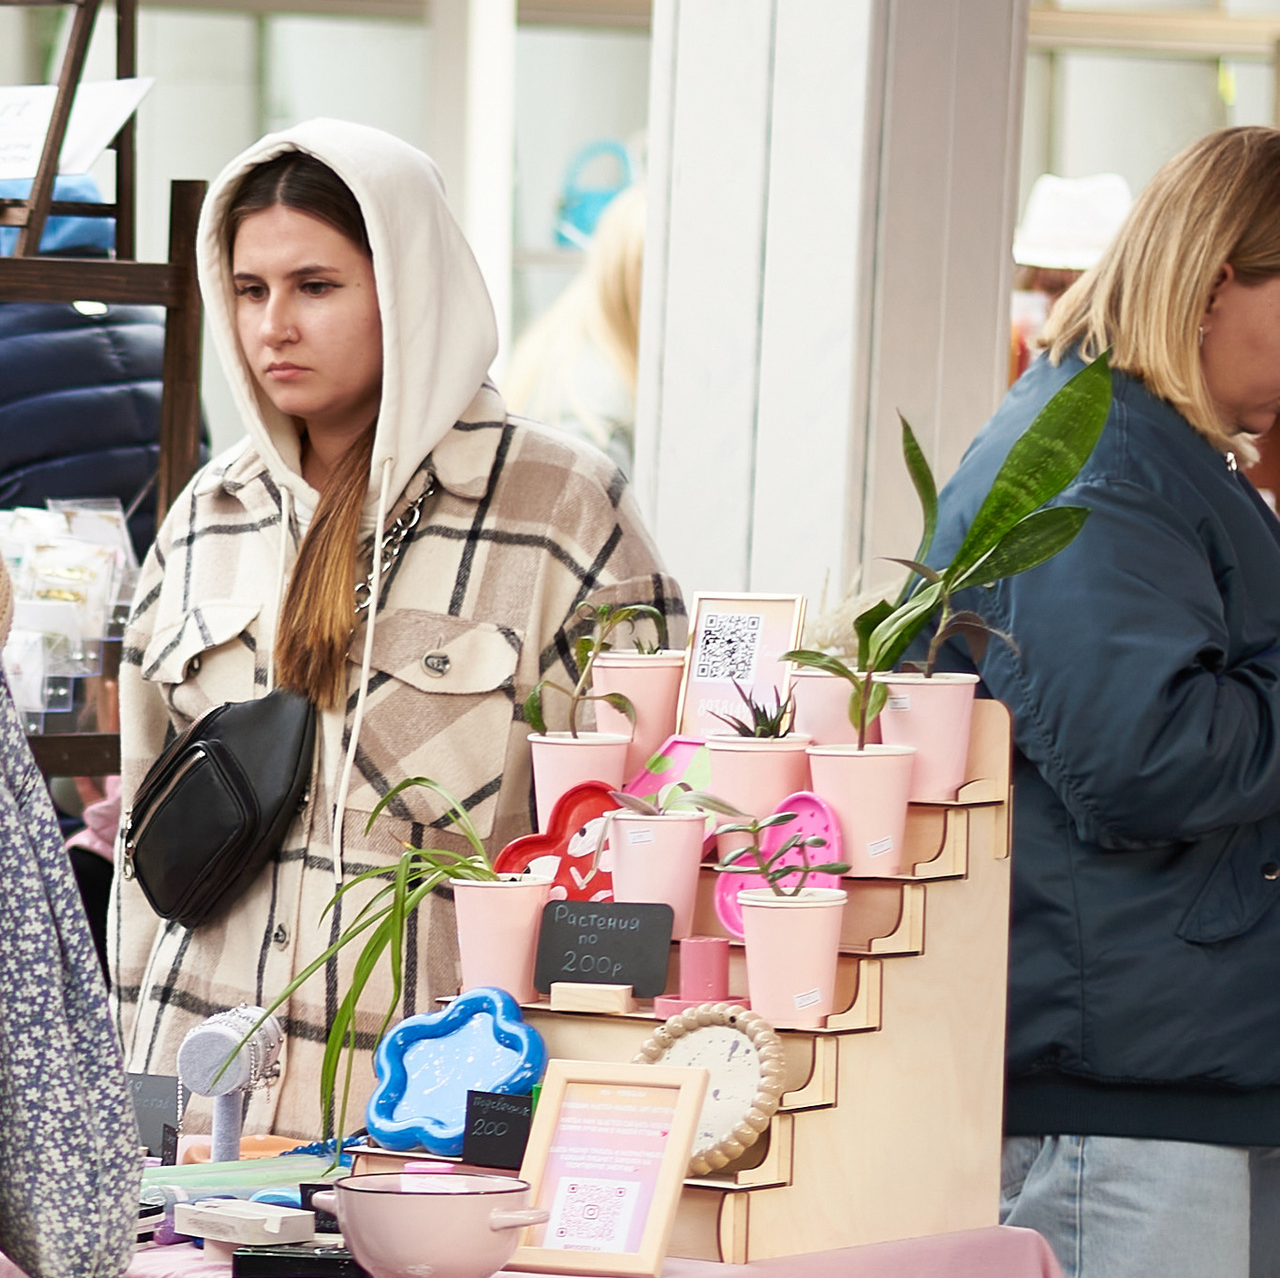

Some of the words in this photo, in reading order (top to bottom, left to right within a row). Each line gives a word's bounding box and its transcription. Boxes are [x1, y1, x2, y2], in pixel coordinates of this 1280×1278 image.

[554, 904, 640, 932] Растения
[578, 933, 599, 945] по
[471, 1118, 509, 1137] 200
